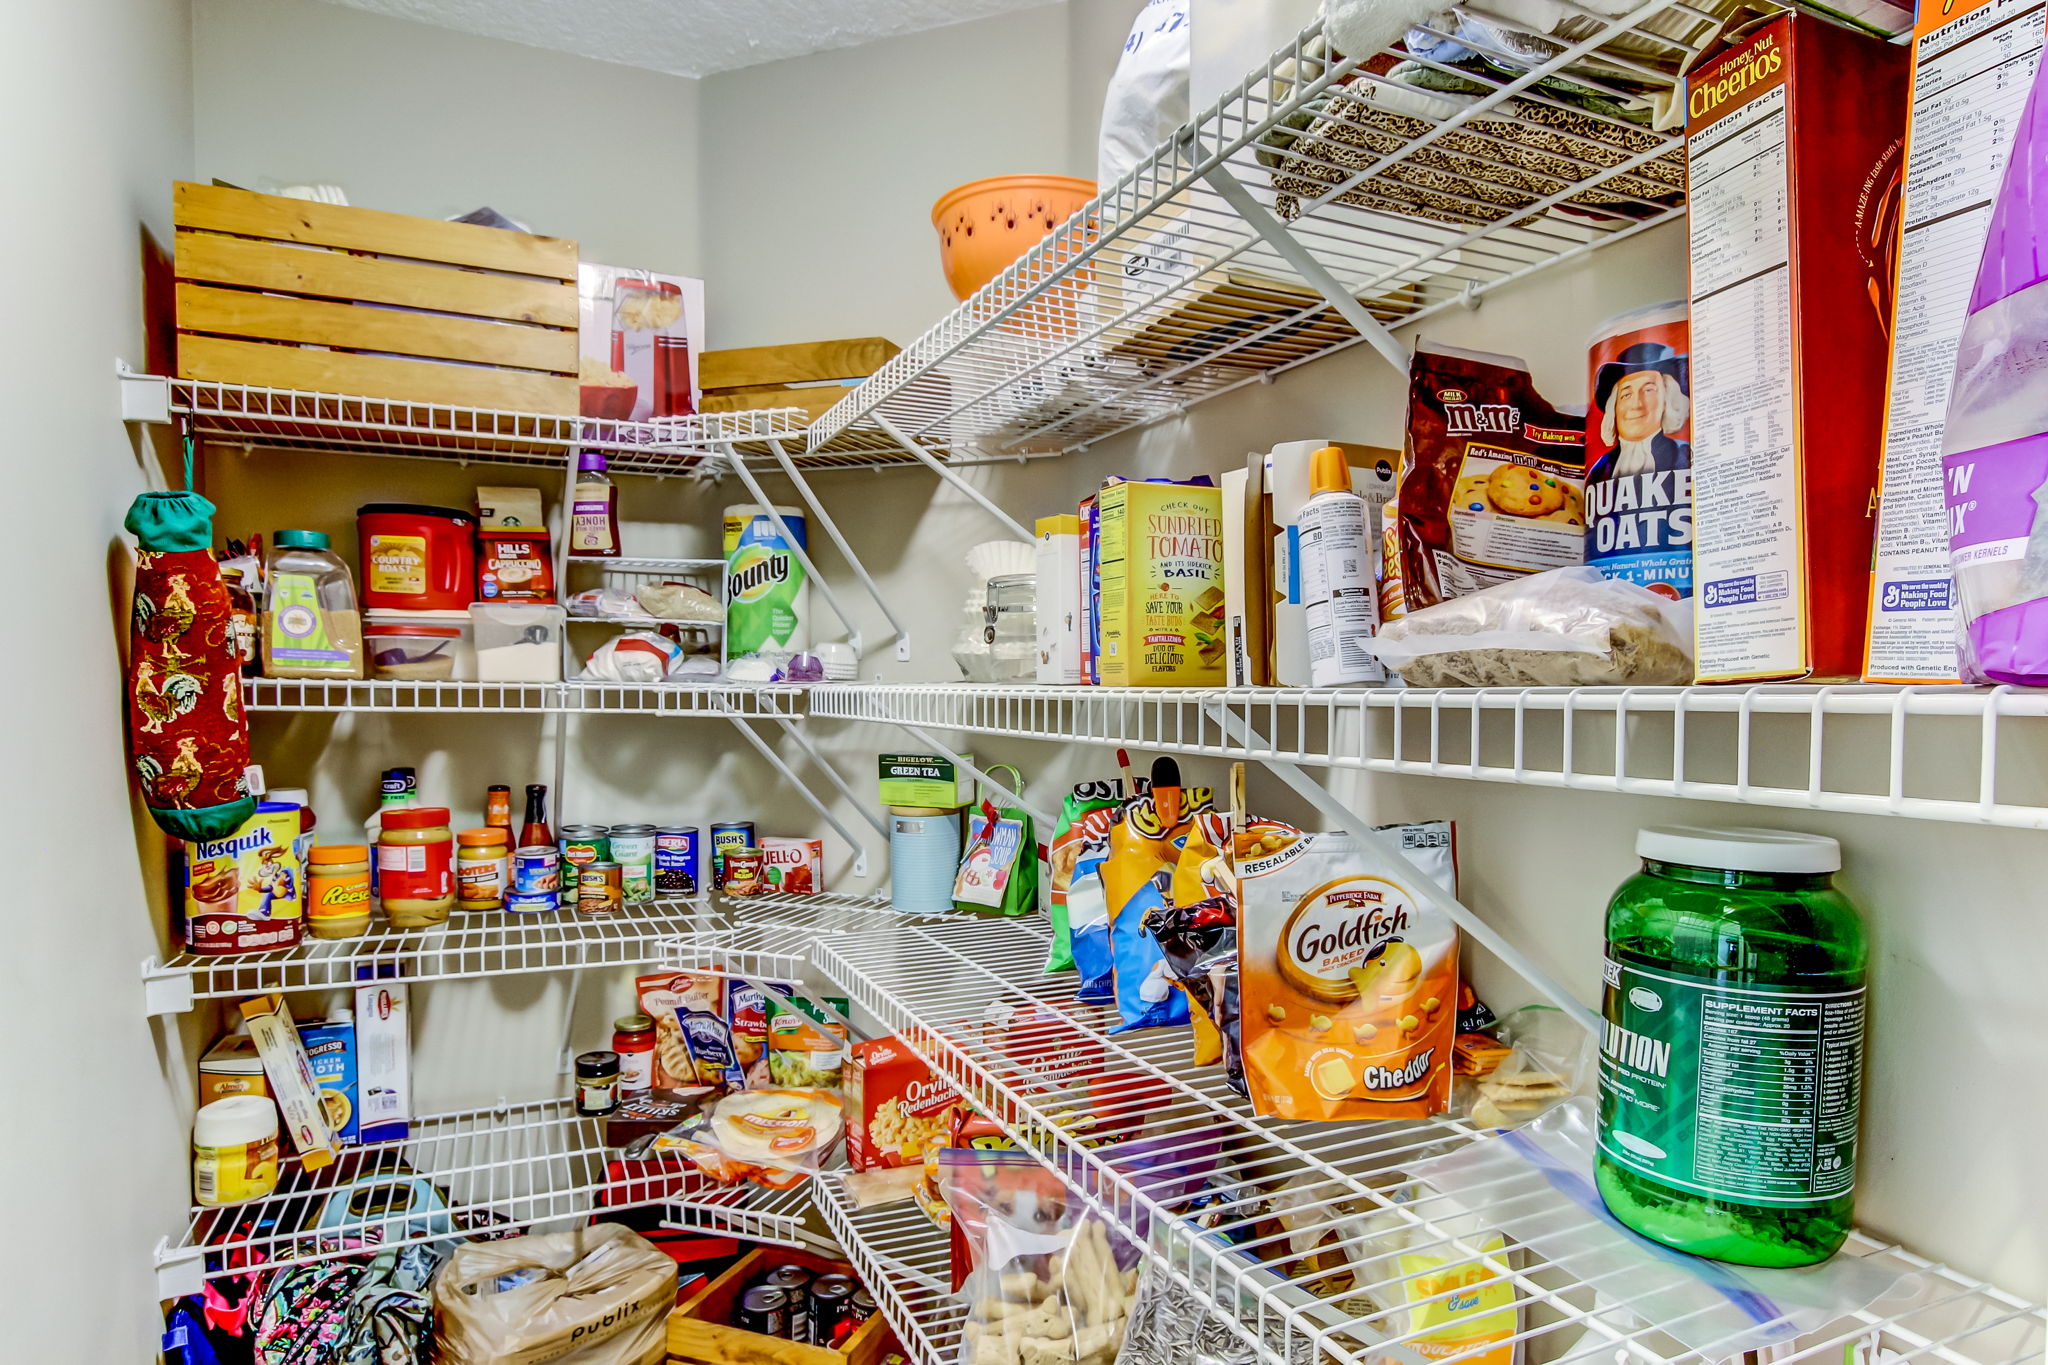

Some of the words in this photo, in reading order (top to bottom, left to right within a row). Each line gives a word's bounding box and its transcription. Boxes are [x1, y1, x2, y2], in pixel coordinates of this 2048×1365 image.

[1920, 7, 1990, 47] Nutrition
[2032, 28, 2044, 38] 160
[1720, 49, 1751, 76] Honey
[1754, 34, 1773, 55] Nut
[1690, 47, 1781, 118] Cheerios
[1916, 76, 1942, 91] Calories
[1914, 105, 1929, 117] Total
[1930, 101, 1942, 111] Fat
[1916, 107, 1943, 125] Saturated
[1945, 103, 1954, 113] Fat
[1689, 112, 1742, 145] Nutrition
[1747, 89, 1783, 112] Facts
[1914, 115, 1961, 142] Polyunsaturated
[1914, 125, 1965, 150] Monounsaturated
[1910, 141, 1948, 160] Cholesterol
[1909, 155, 1934, 169] Sodium
[1871, 160, 1883, 181] taste
[1908, 160, 1943, 178] Potassium
[1907, 172, 1952, 193] Carbohydrate
[1908, 176, 1924, 187] Total
[1931, 183, 1946, 193] Fiber
[1905, 214, 1928, 227] Protein
[1924, 423, 1944, 431] Whole
[1532, 429, 1541, 439] Try
[1542, 432, 1563, 442] Baking
[1912, 431, 1933, 440] Peanut
[1470, 448, 1487, 456] Red's
[1488, 450, 1512, 461] Amazing
[1376, 467, 1392, 475] Publix
[1886, 460, 1914, 469] Hershey's
[1885, 467, 1914, 476] Trisodium
[1885, 481, 1910, 489] Preserve
[1586, 469, 1691, 528] QUAKE
[1161, 502, 1188, 511] CHECK
[1193, 504, 1208, 514] OUT
[1302, 506, 1320, 519] Facts
[576, 516, 606, 526] HONEY
[1148, 514, 1221, 537] SUNDRIED
[1313, 531, 1322, 540] 80
[1597, 508, 1692, 552] OATS
[497, 544, 530, 554] HILLS
[1147, 536, 1223, 563] TOMATO
[1880, 549, 1910, 557] CONTAINS
[1911, 546, 1938, 555] PEANUT
[1974, 546, 2008, 560] KERNELS
[372, 556, 420, 565] COUNTRY
[488, 559, 542, 570] CAPPUCCINO
[1188, 562, 1212, 570] SIDEKICK
[1612, 561, 1640, 570] Natural
[1641, 558, 1668, 568] Whole
[1164, 569, 1209, 580] BASIL
[1741, 584, 1754, 592] Food
[1719, 595, 1738, 604] People
[1901, 591, 1928, 601] Making
[1929, 590, 1947, 598] Food
[1146, 601, 1164, 613] SAVE
[1165, 601, 1183, 614] YOUR
[1901, 600, 1925, 609] People
[1928, 599, 1946, 607] Love
[1146, 615, 1165, 626] TASTE
[1167, 615, 1182, 626] BUDS
[1148, 634, 1182, 643] TANTALIZING
[1145, 653, 1184, 665] DELICIOUS
[890, 766, 920, 776] GREEN
[922, 768, 940, 776] TEA
[197, 828, 272, 860] Nesquik
[716, 835, 744, 845] BUSH'S
[991, 846, 1011, 865] SOUP
[1244, 842, 1304, 874] RESEALABLE
[1306, 835, 1315, 845] BA
[1329, 892, 1362, 903] PEPPERIDGE
[1364, 892, 1380, 901] FARM
[1296, 904, 1408, 963] Goldfish
[1322, 947, 1365, 967] BAKED
[686, 991, 708, 1001] Butter
[1705, 1000, 1782, 1015] SUPPLEMENT
[1364, 1047, 1436, 1090] Cheddar
[898, 1088, 962, 1118] Redenbache
[744, 1114, 808, 1128] mission
[570, 1299, 640, 1342] publix
